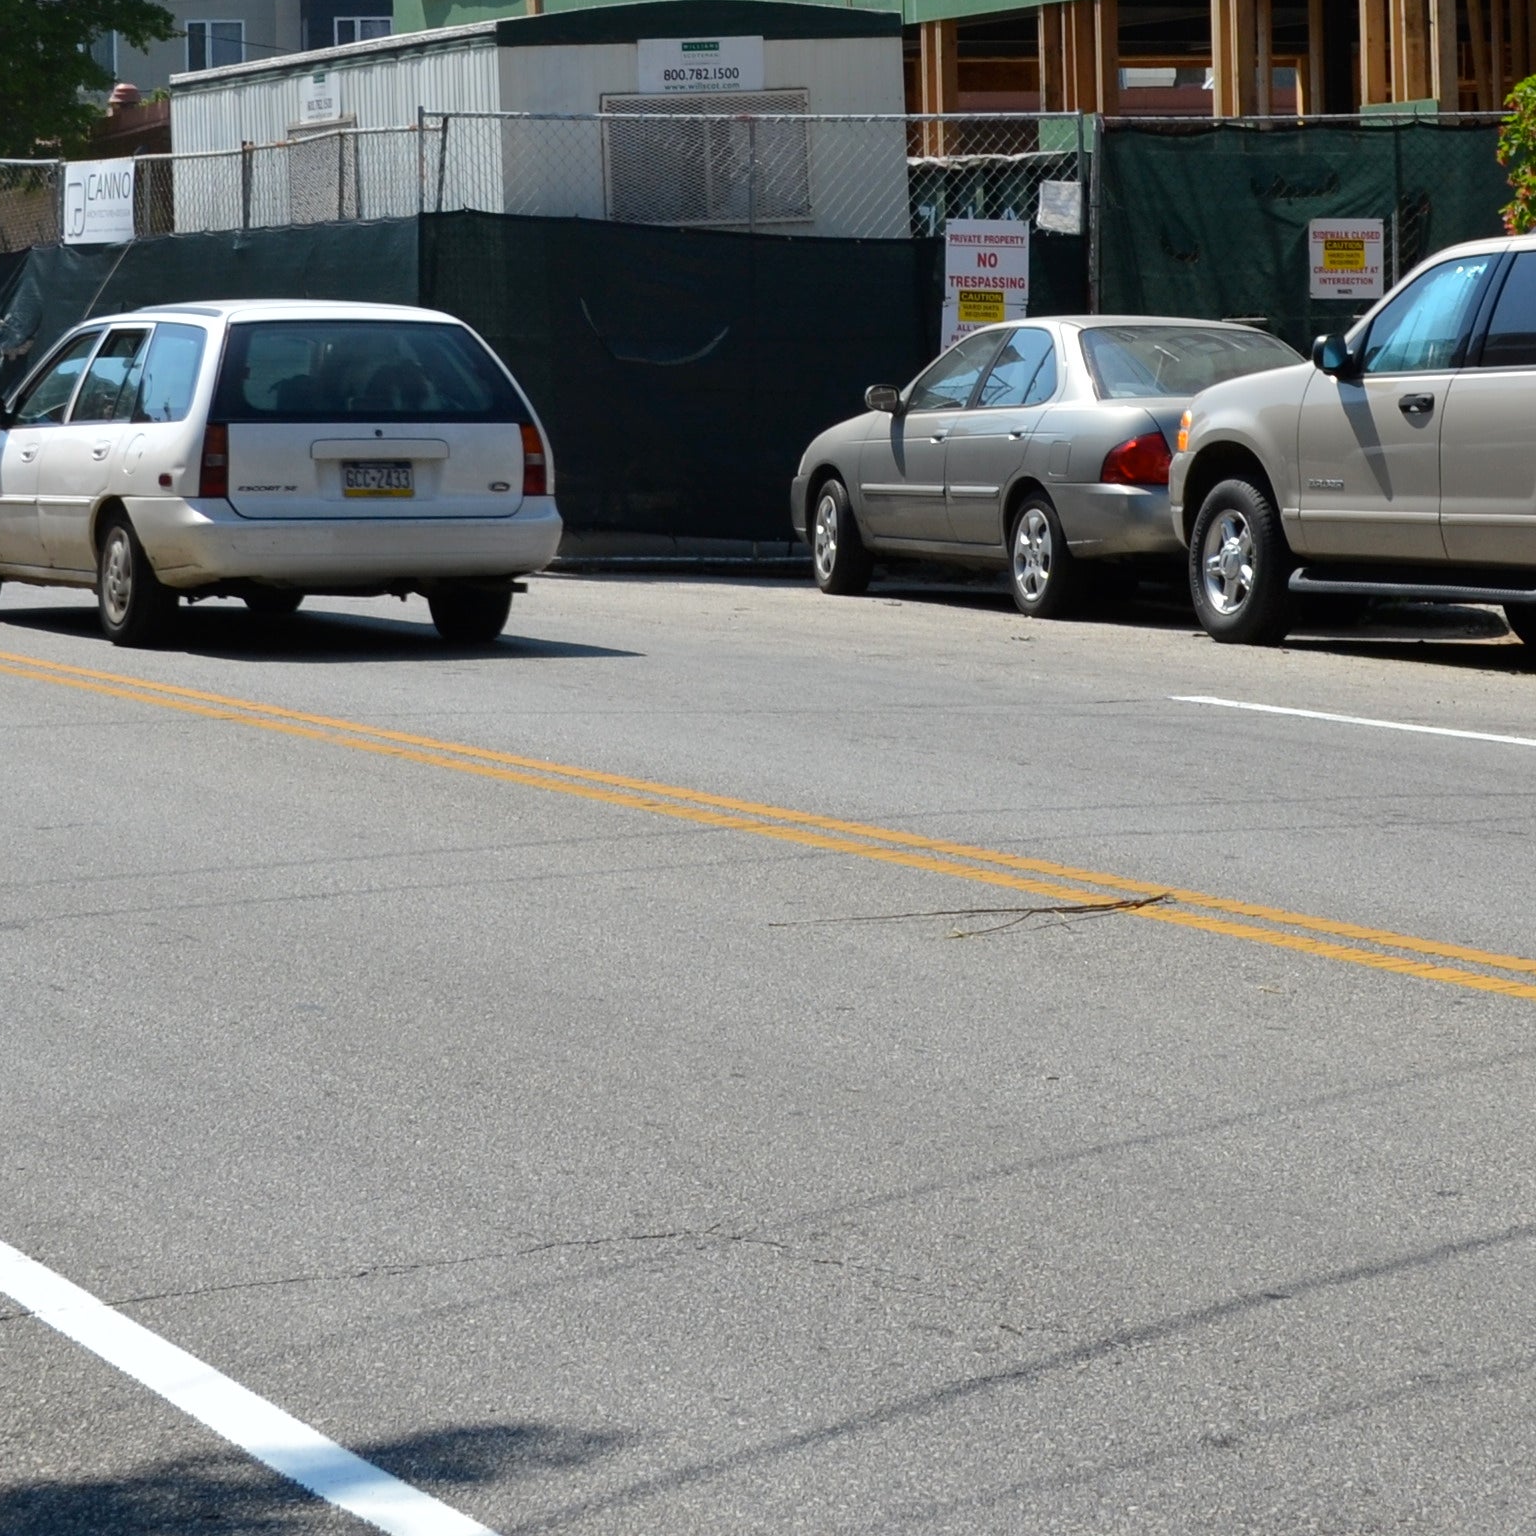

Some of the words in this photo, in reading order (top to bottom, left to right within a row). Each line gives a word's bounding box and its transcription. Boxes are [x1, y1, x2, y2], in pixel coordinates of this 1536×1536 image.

[664, 67, 740, 81] 800.782.1500
[664, 82, 740, 91] www.willscot.com
[88, 172, 131, 201] CANNO
[950, 234, 982, 244] PRIVATE
[984, 235, 1025, 245] PROPERTY
[1312, 231, 1349, 240] SIDEWALK
[1351, 231, 1381, 240] CLOSED
[1326, 241, 1363, 249] CAUTION
[977, 252, 998, 268] NO
[949, 275, 1026, 289] TRESPASSING
[1319, 277, 1374, 285] INTERSECTION
[961, 293, 1002, 302] CAUTION
